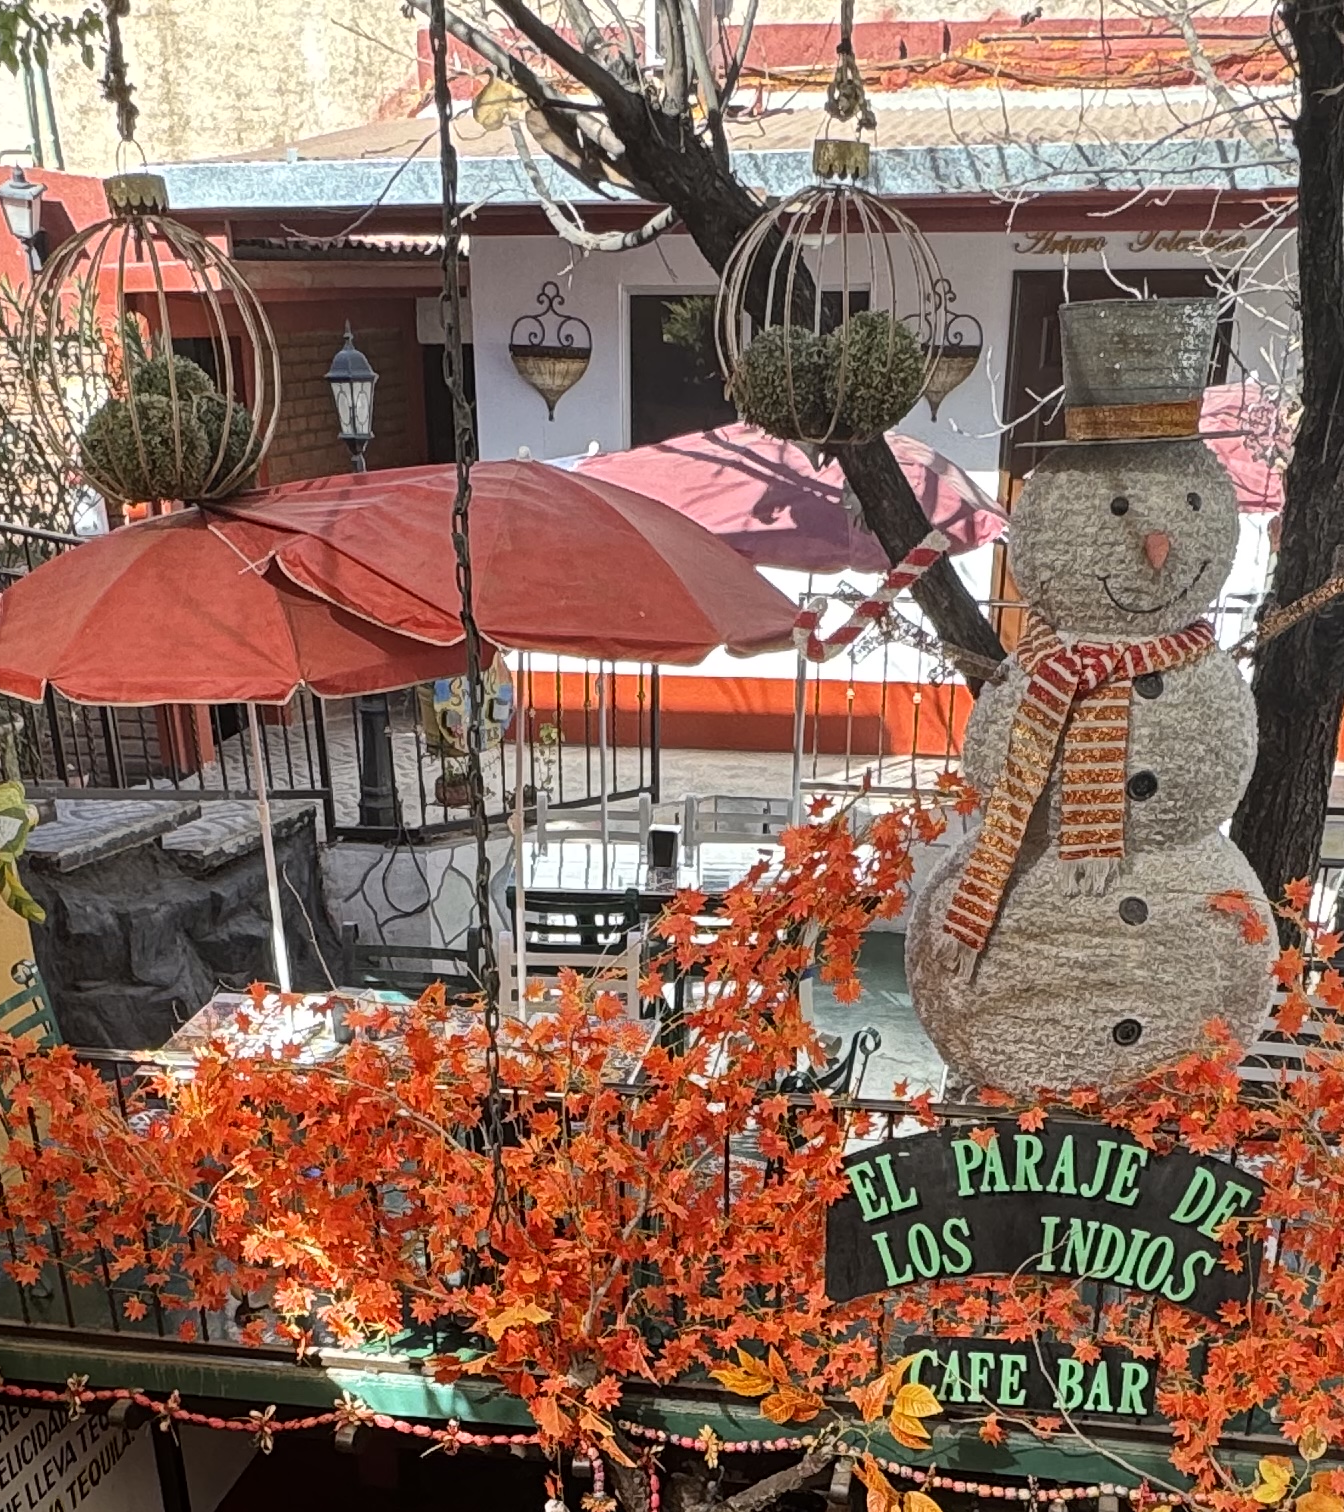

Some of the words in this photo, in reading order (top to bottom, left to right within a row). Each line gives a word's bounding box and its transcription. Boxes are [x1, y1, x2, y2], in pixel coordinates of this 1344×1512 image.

[846, 1153, 918, 1223] EL
[950, 1134, 1150, 1206] PARAJE
[1170, 1167, 1253, 1239] DE
[872, 1218, 973, 1287] LOS
[1036, 1216, 1218, 1302] INDIOS
[910, 1348, 1028, 1406] CAFE
[1053, 1358, 1150, 1416] BAR
[25, 1440, 78, 1510] LLEVA
